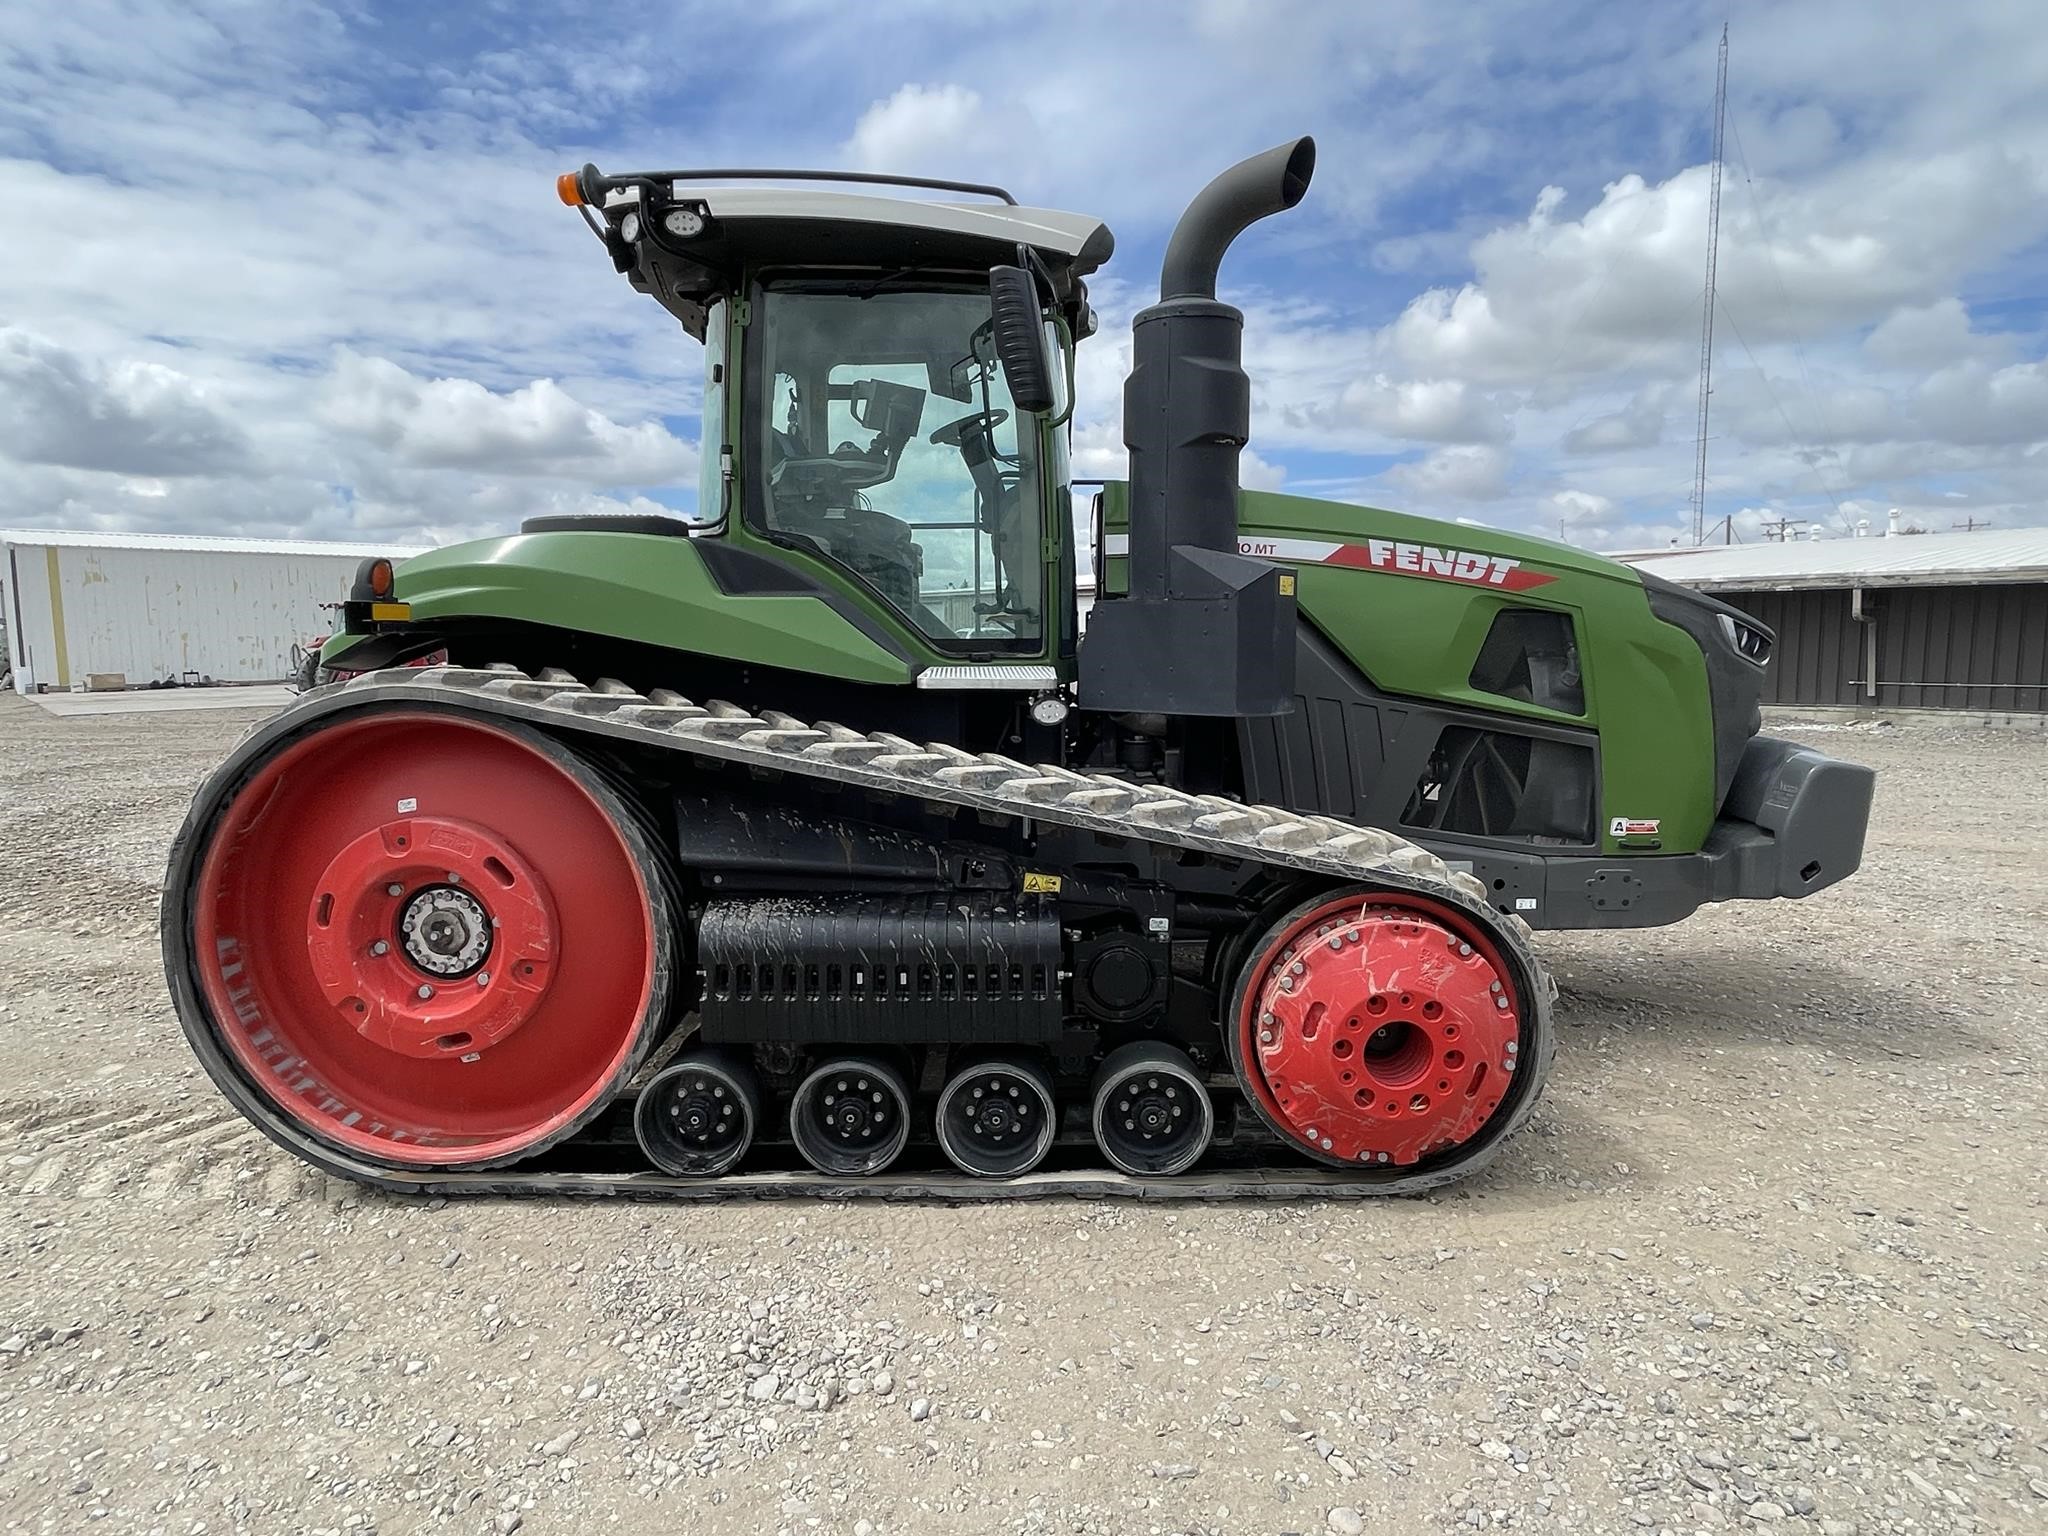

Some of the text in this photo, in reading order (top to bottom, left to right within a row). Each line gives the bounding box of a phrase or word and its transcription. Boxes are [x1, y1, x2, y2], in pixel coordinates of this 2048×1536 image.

[1255, 543, 1277, 555] MT
[1368, 538, 1521, 584] FENDT
[1614, 821, 1624, 832] A
